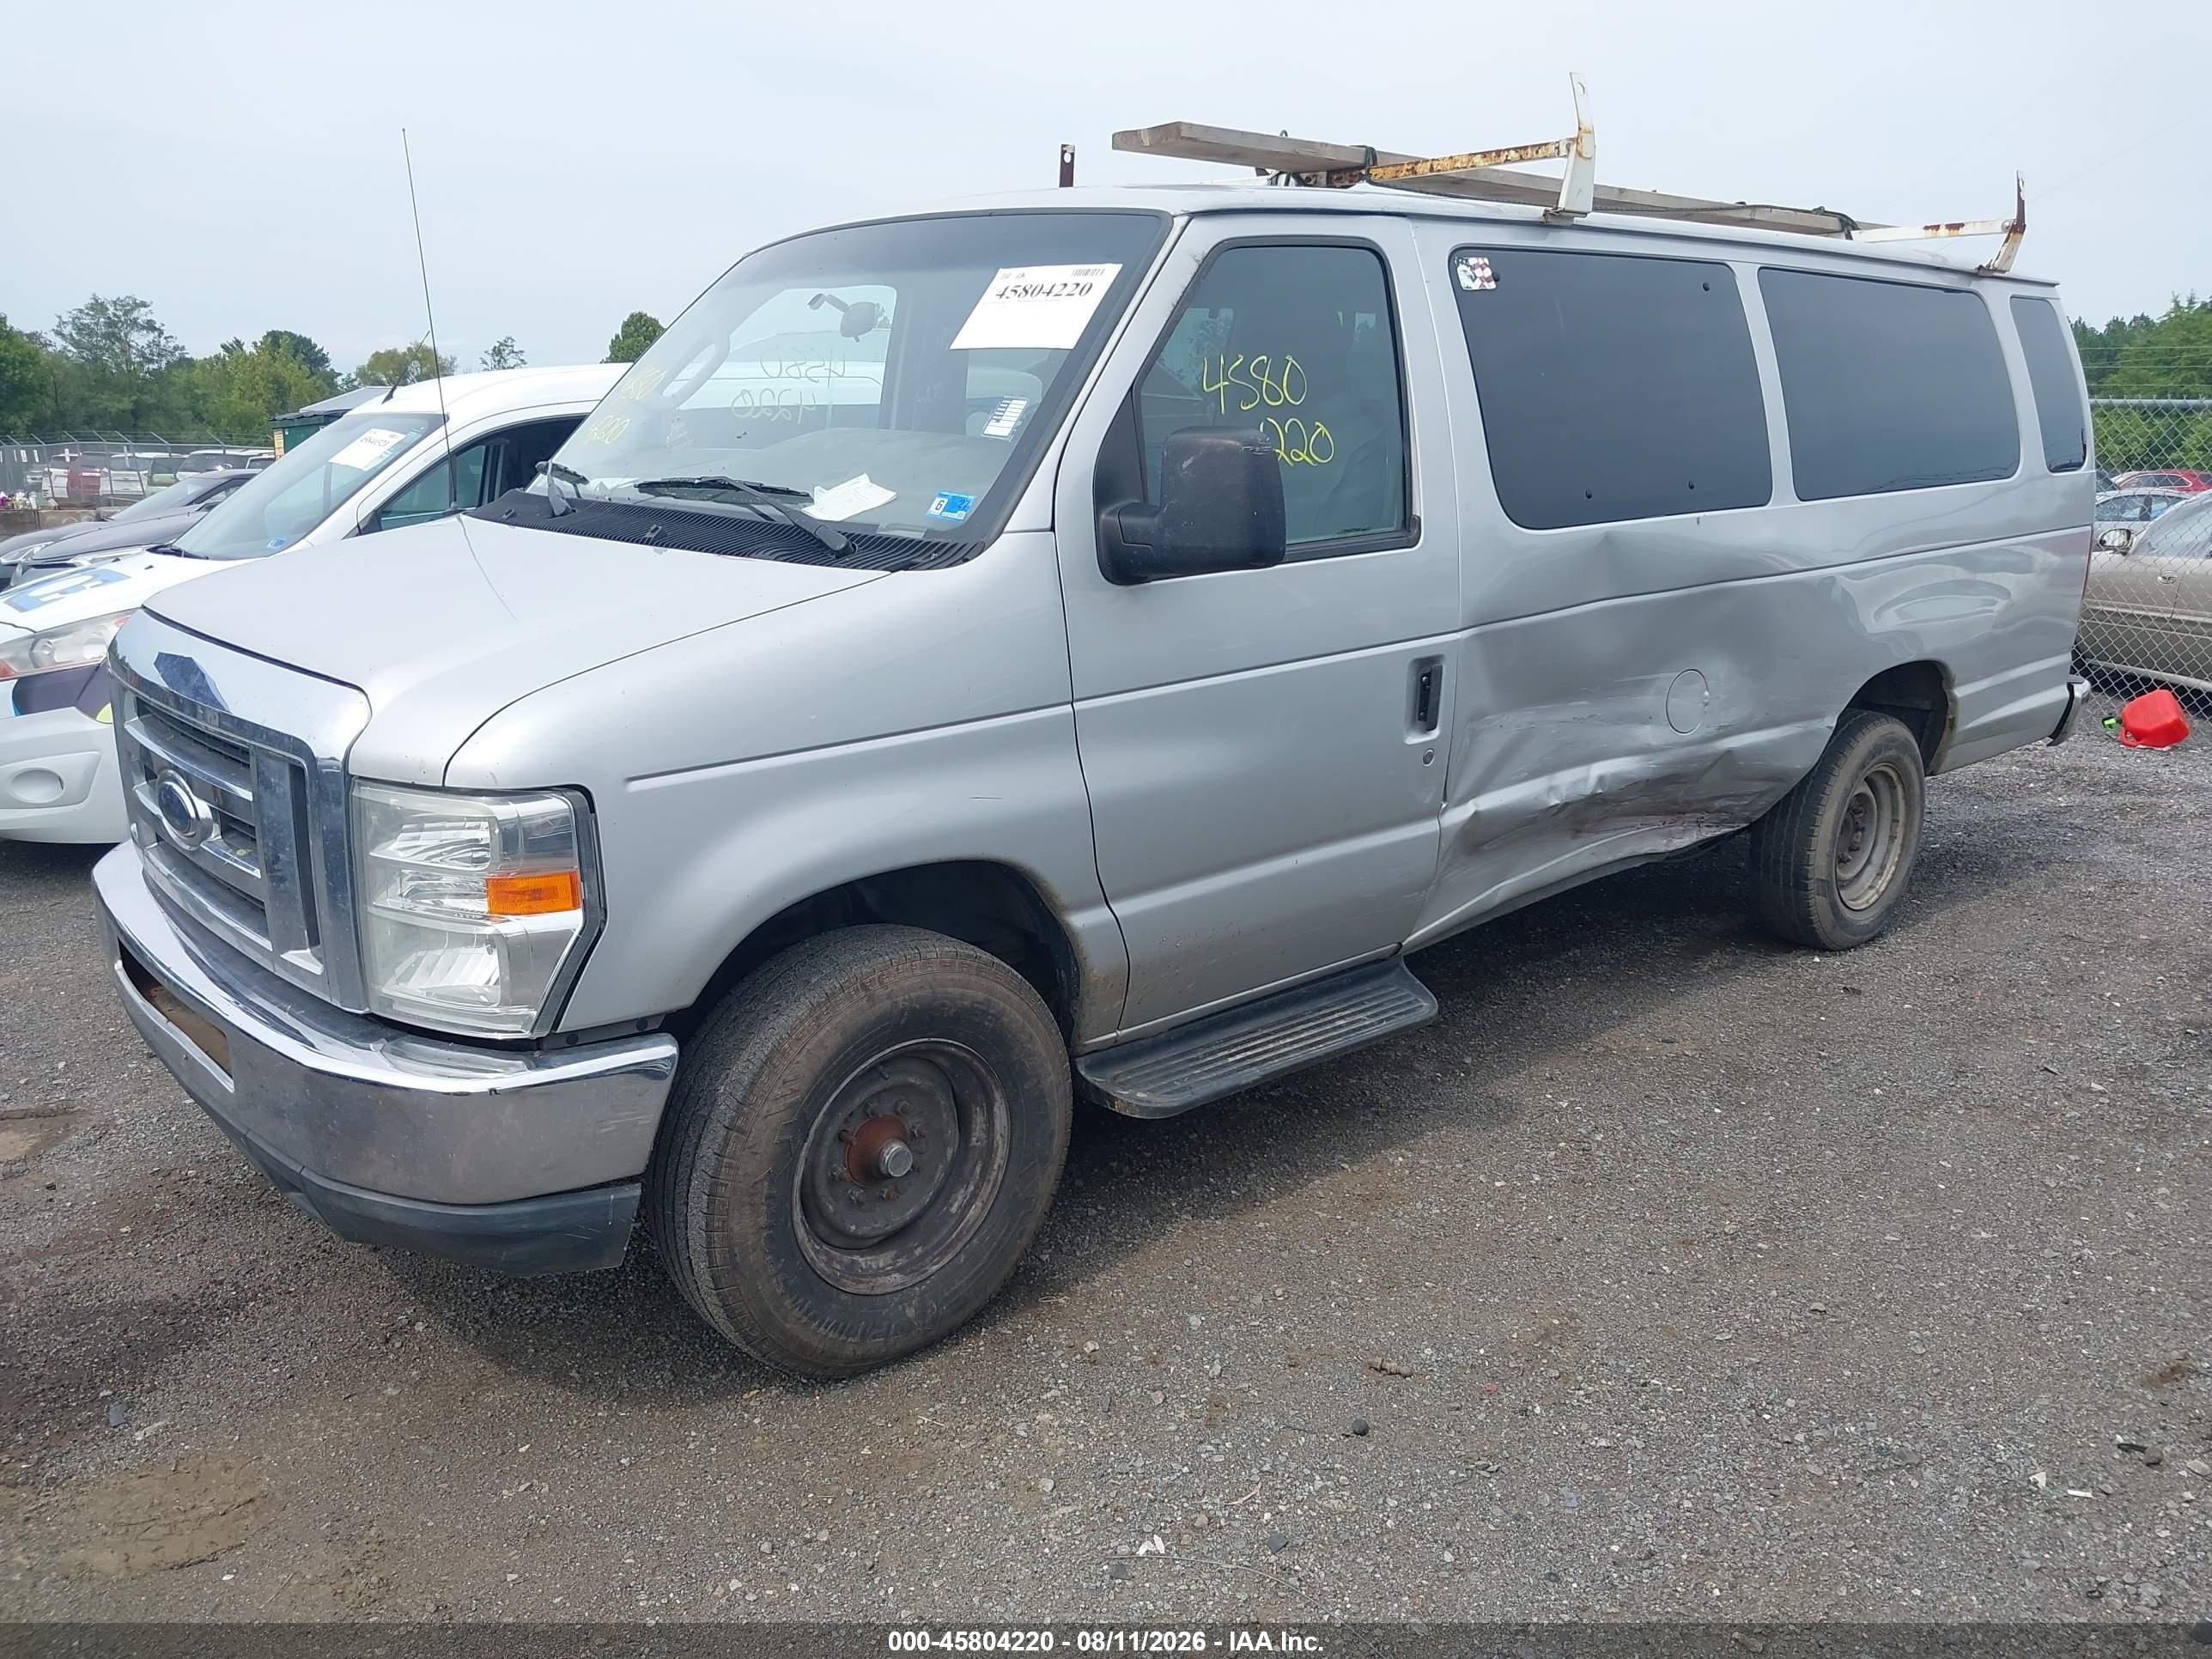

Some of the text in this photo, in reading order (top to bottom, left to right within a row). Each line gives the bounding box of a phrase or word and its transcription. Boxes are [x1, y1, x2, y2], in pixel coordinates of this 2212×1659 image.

[995, 282, 1093, 300] 45804220
[1203, 354, 1307, 415] 4580
[1259, 417, 1334, 466] 220
[935, 500, 945, 511] 6
